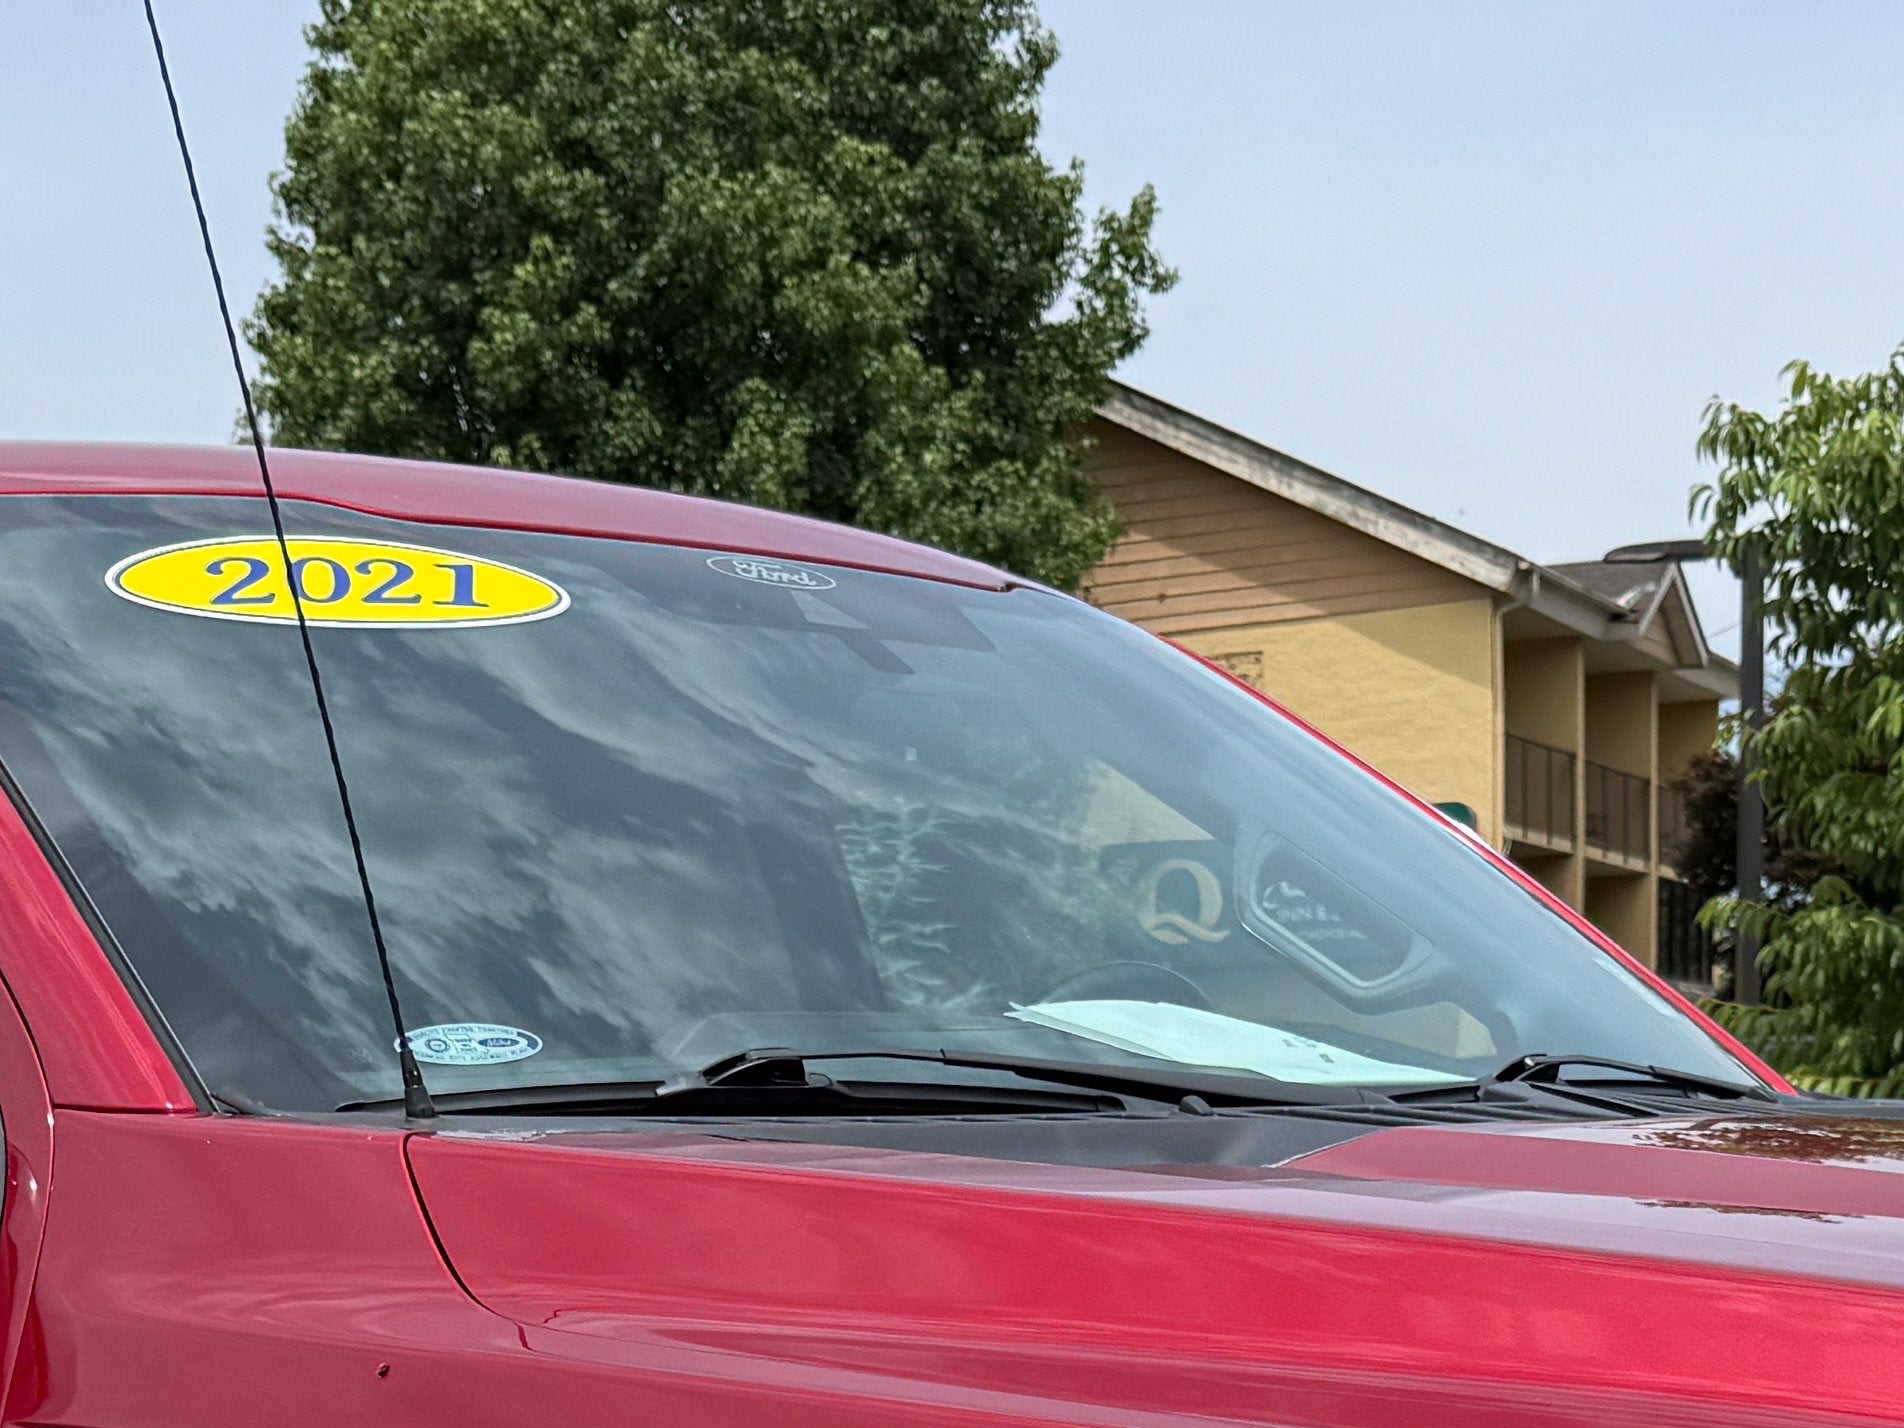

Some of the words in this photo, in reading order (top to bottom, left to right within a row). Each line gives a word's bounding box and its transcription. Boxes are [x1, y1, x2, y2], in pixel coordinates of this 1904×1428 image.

[204, 555, 491, 609] 2021
[731, 559, 818, 586] Ford
[1137, 857, 1231, 945] Q
